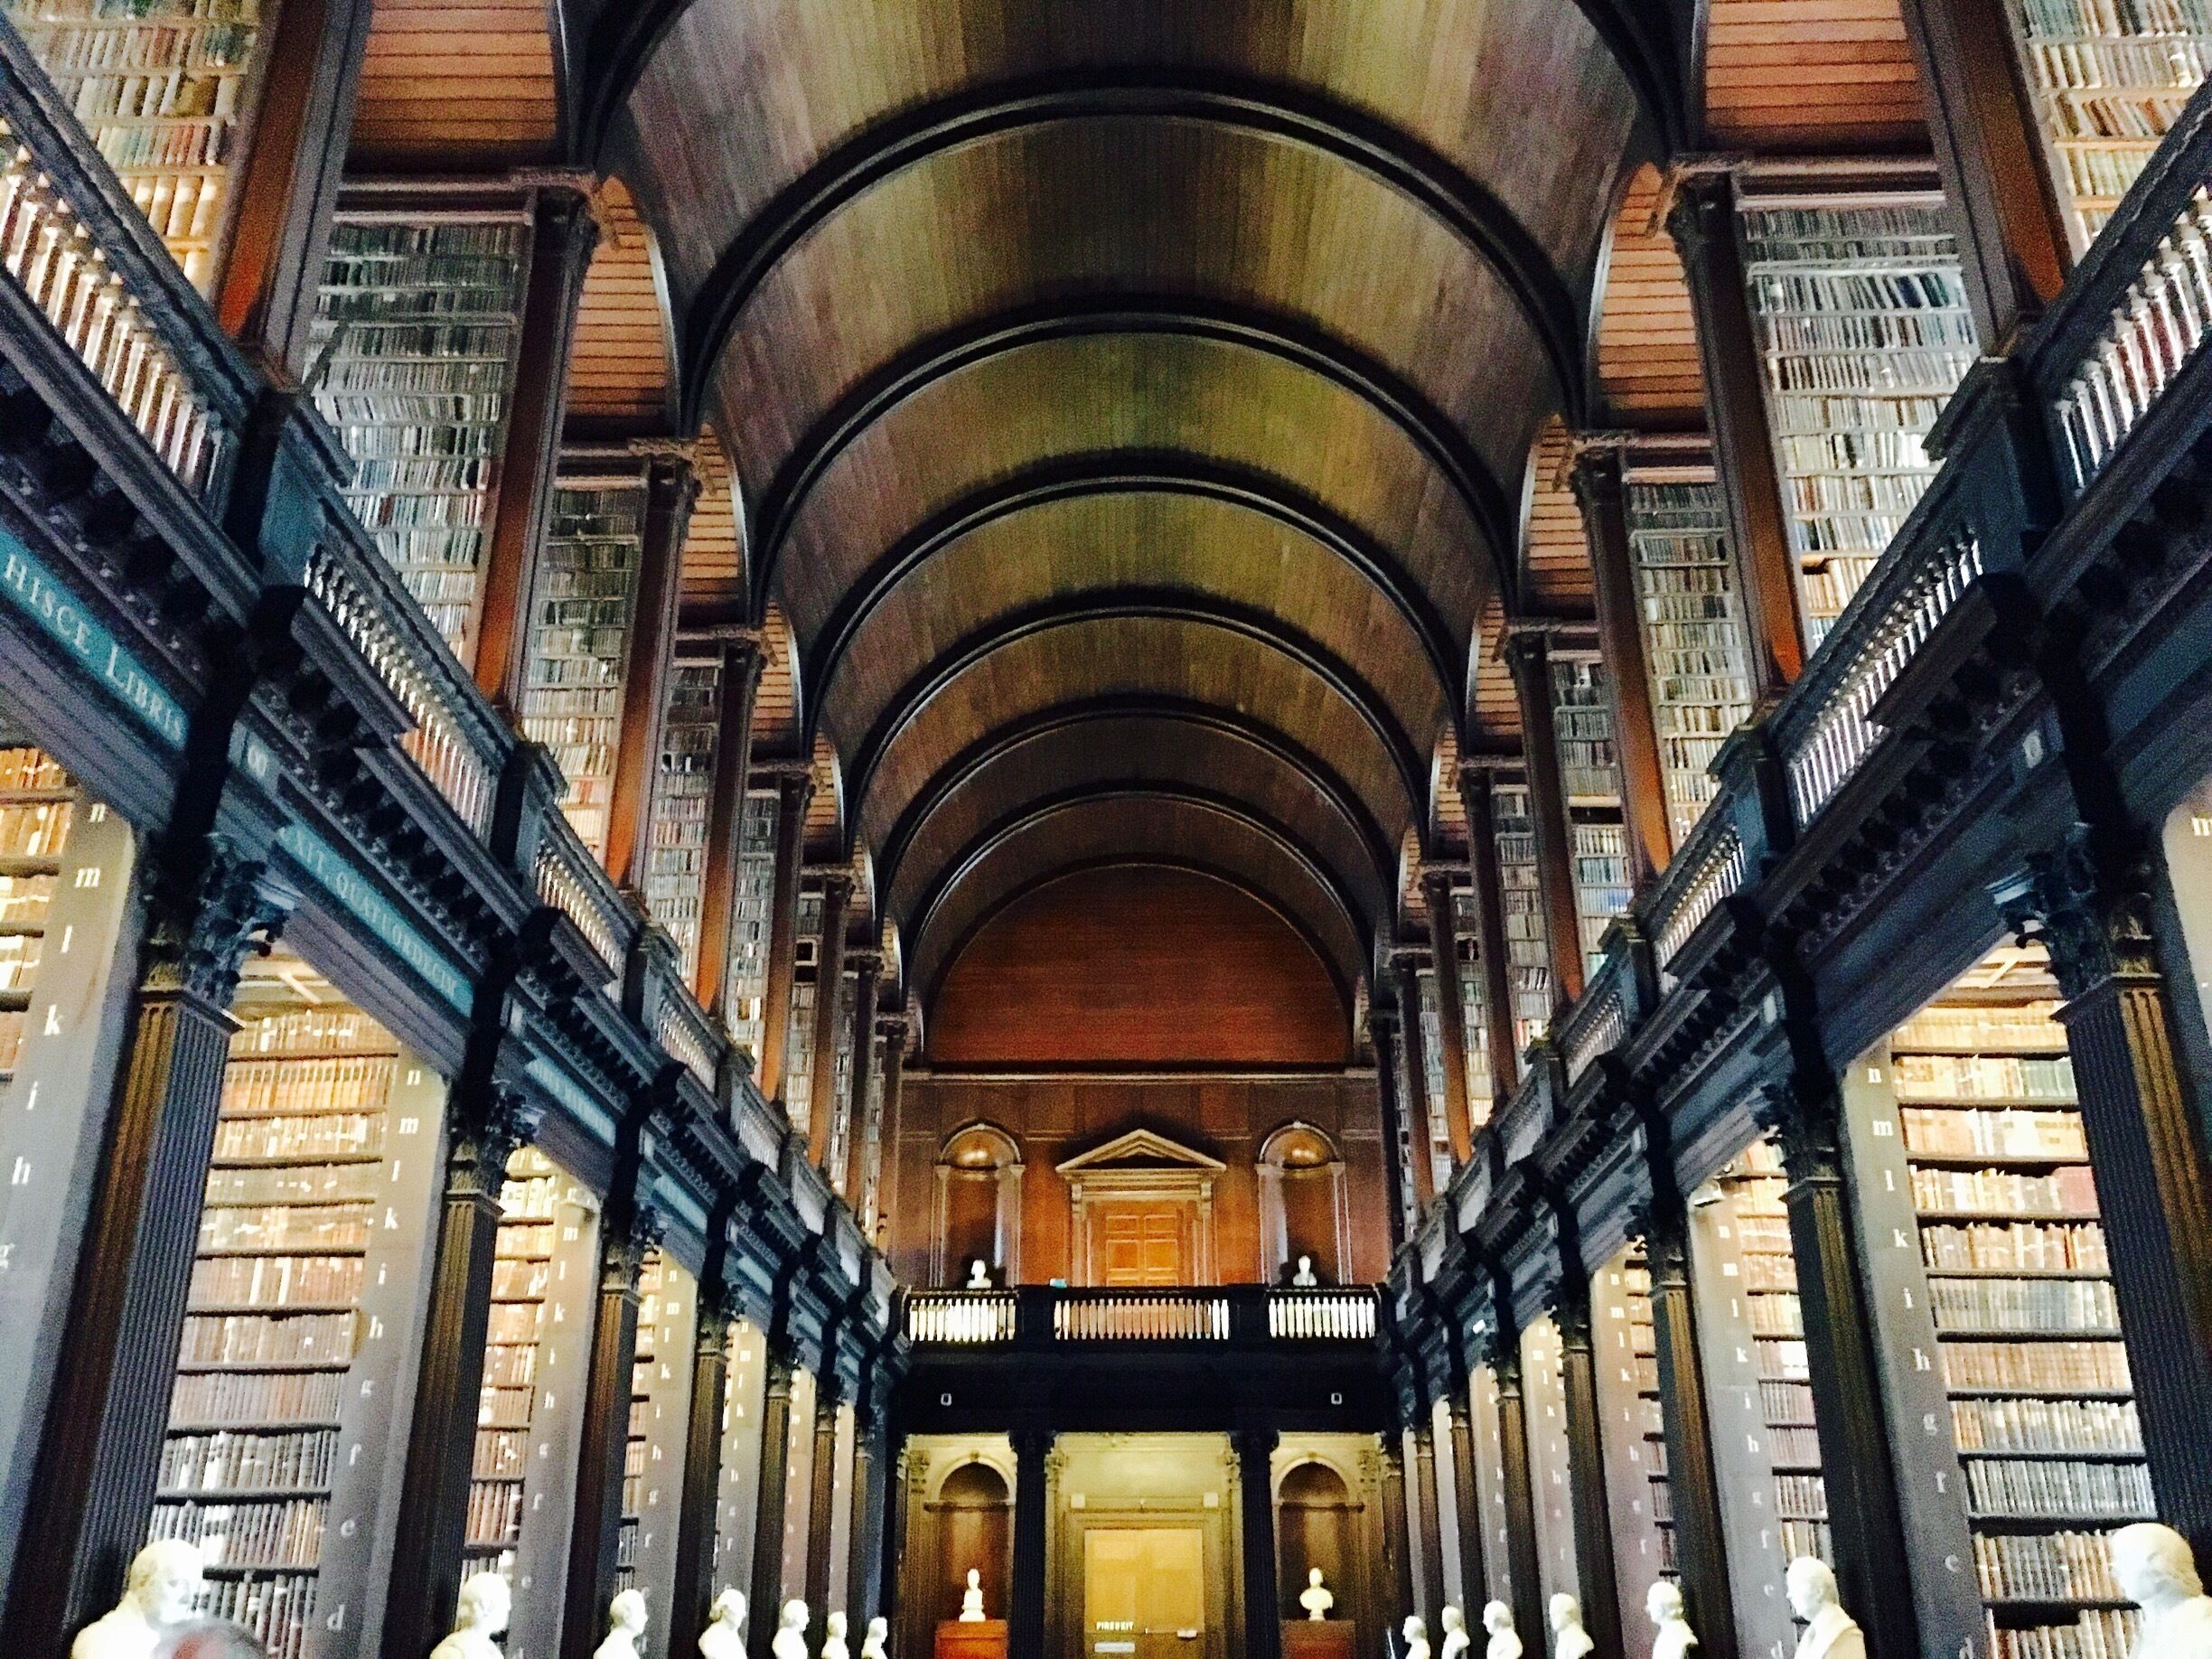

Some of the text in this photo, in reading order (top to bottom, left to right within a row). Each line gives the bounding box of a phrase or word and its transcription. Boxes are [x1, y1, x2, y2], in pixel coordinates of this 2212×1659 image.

[89, 804, 106, 822] n
[75, 867, 100, 887] m
[61, 926, 72, 952] l
[44, 1005, 61, 1036] k
[408, 1071, 420, 1085] n
[1869, 1068, 1881, 1083] n
[27, 1082, 38, 1110] i
[399, 1118, 418, 1134] m
[1873, 1120, 1893, 1136] m
[12, 1157, 31, 1185] h
[392, 1160, 400, 1181] l
[1885, 1170, 1895, 1191] l
[385, 1207, 398, 1229] k
[1894, 1229, 1907, 1247] k
[1904, 1289, 1913, 1308] i
[370, 1316, 383, 1338] h
[1914, 1349, 1930, 1370] h
[1924, 1414, 1937, 1435] g
[349, 1444, 361, 1466] f
[341, 1520, 354, 1536] e
[327, 1605, 344, 1630] d
